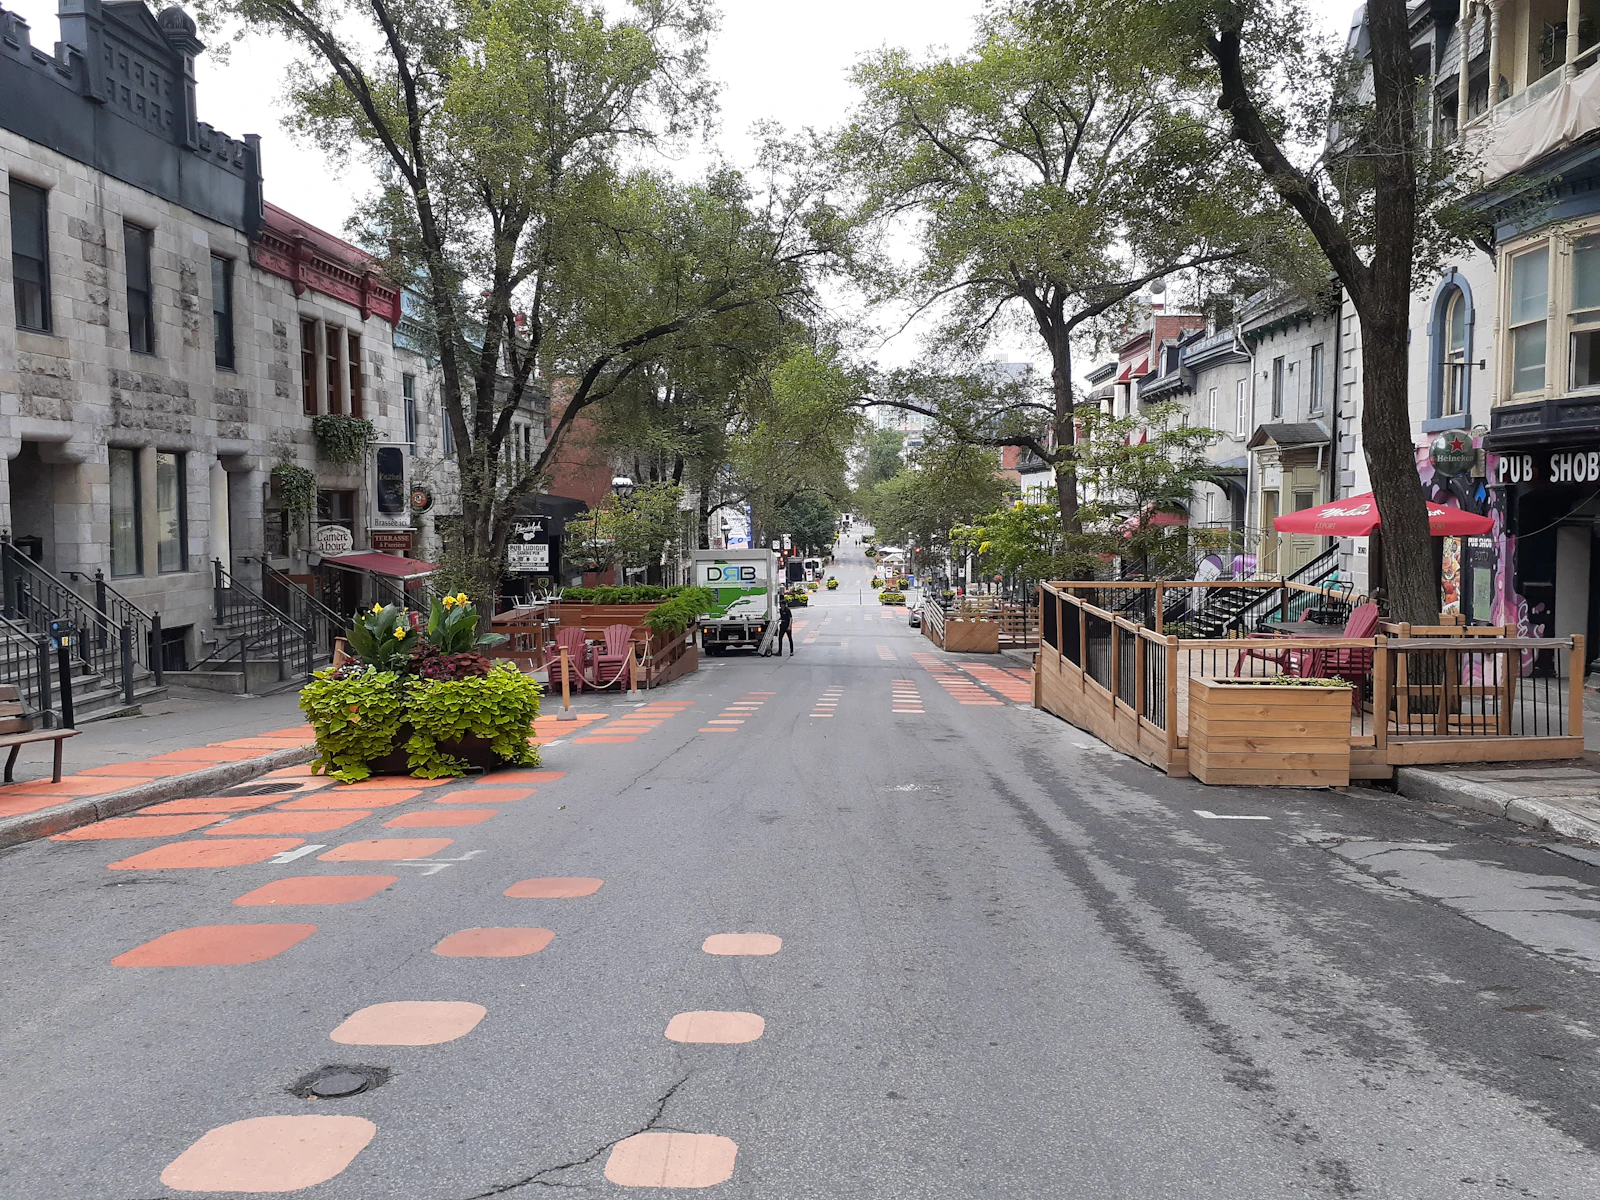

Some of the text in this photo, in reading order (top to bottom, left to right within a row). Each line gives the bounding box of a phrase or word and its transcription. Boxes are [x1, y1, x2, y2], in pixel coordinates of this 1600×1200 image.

[1500, 452, 1600, 483] PUB SHOB
[1315, 522, 1337, 530] EXPORT
[325, 541, 348, 550] boire
[1468, 538, 1478, 547] PUB
[707, 566, 756, 582] DRB
